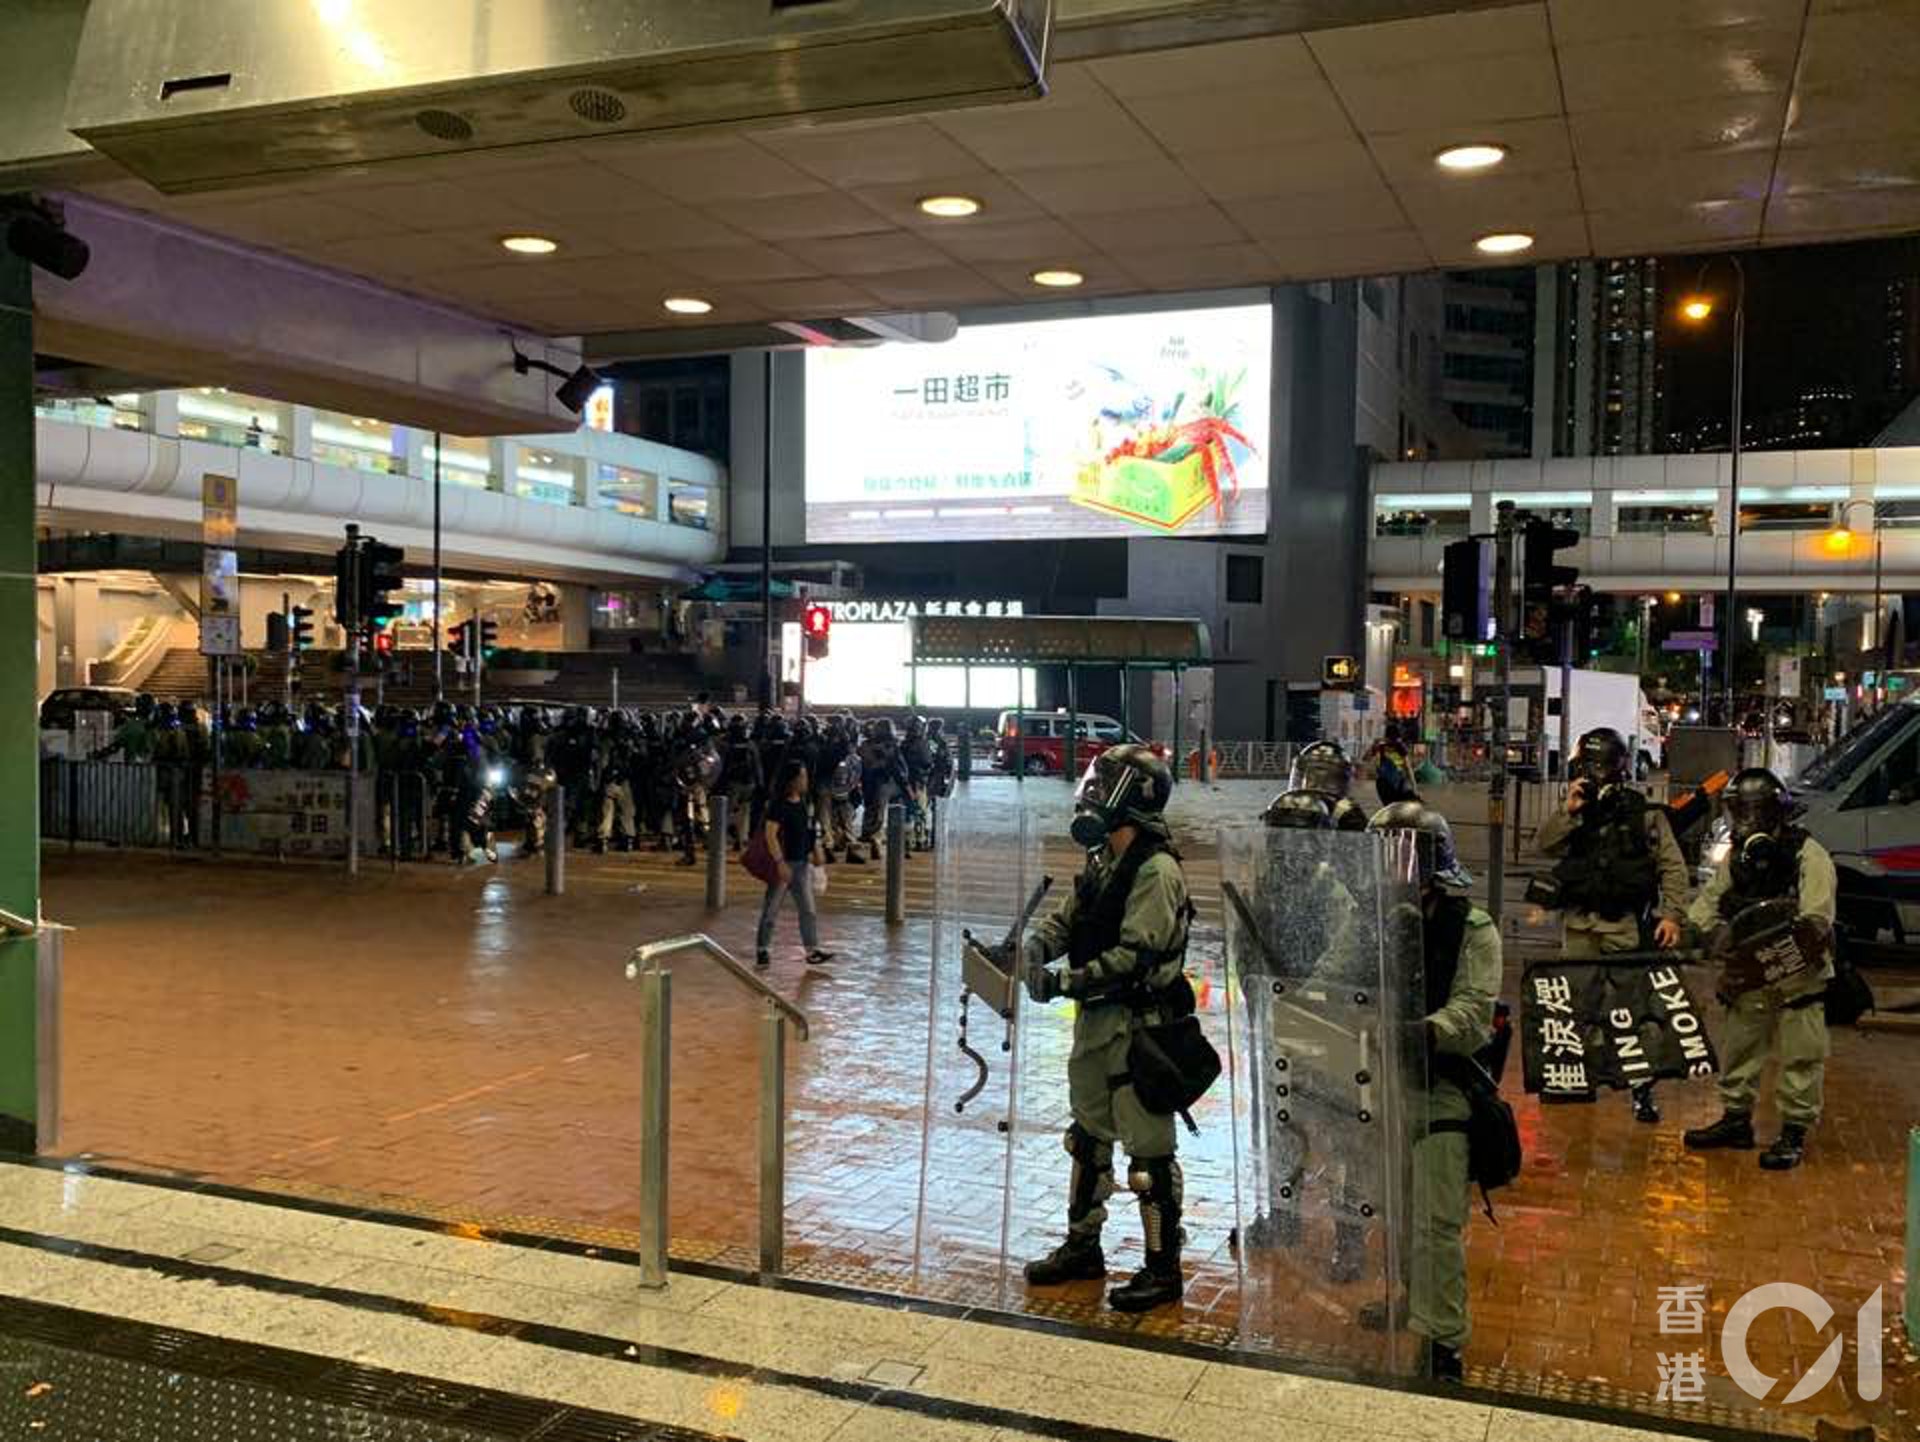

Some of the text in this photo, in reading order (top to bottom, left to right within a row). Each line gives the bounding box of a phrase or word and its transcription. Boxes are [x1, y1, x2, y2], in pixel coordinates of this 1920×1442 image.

[893, 372, 1012, 405] 一田超市
[1649, 966, 1712, 1078] SMOKE
